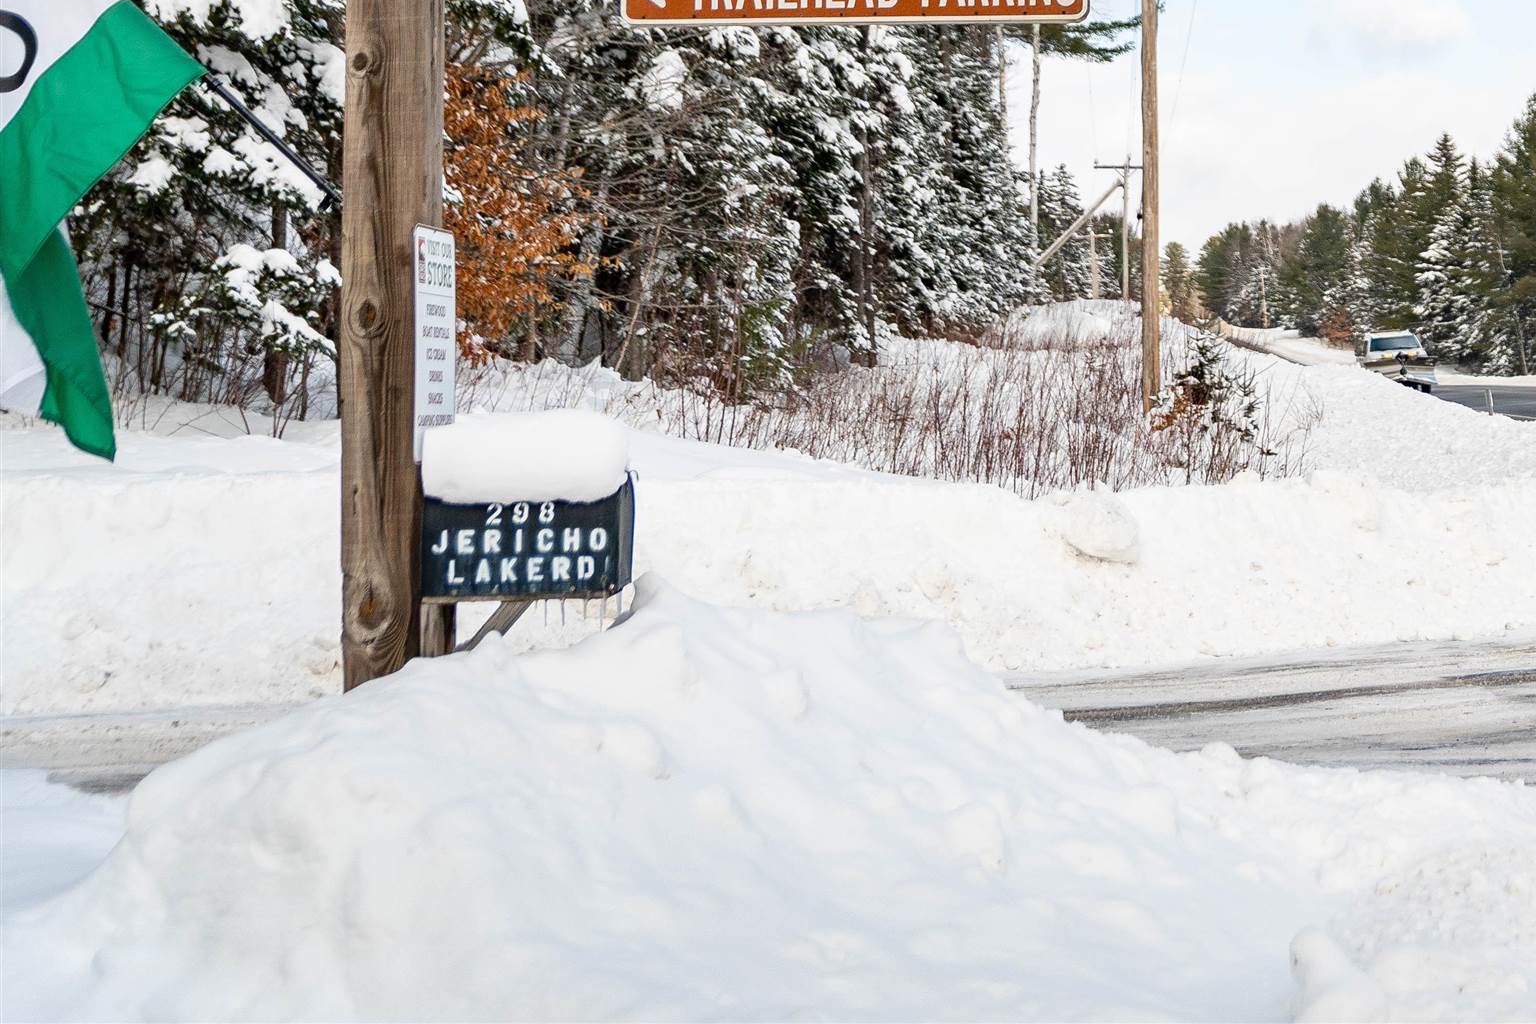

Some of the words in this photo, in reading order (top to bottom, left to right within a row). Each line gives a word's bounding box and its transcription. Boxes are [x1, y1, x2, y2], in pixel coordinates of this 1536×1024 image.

[427, 261, 452, 289] STORE
[486, 502, 555, 527] 298
[431, 527, 608, 554] JERICHO
